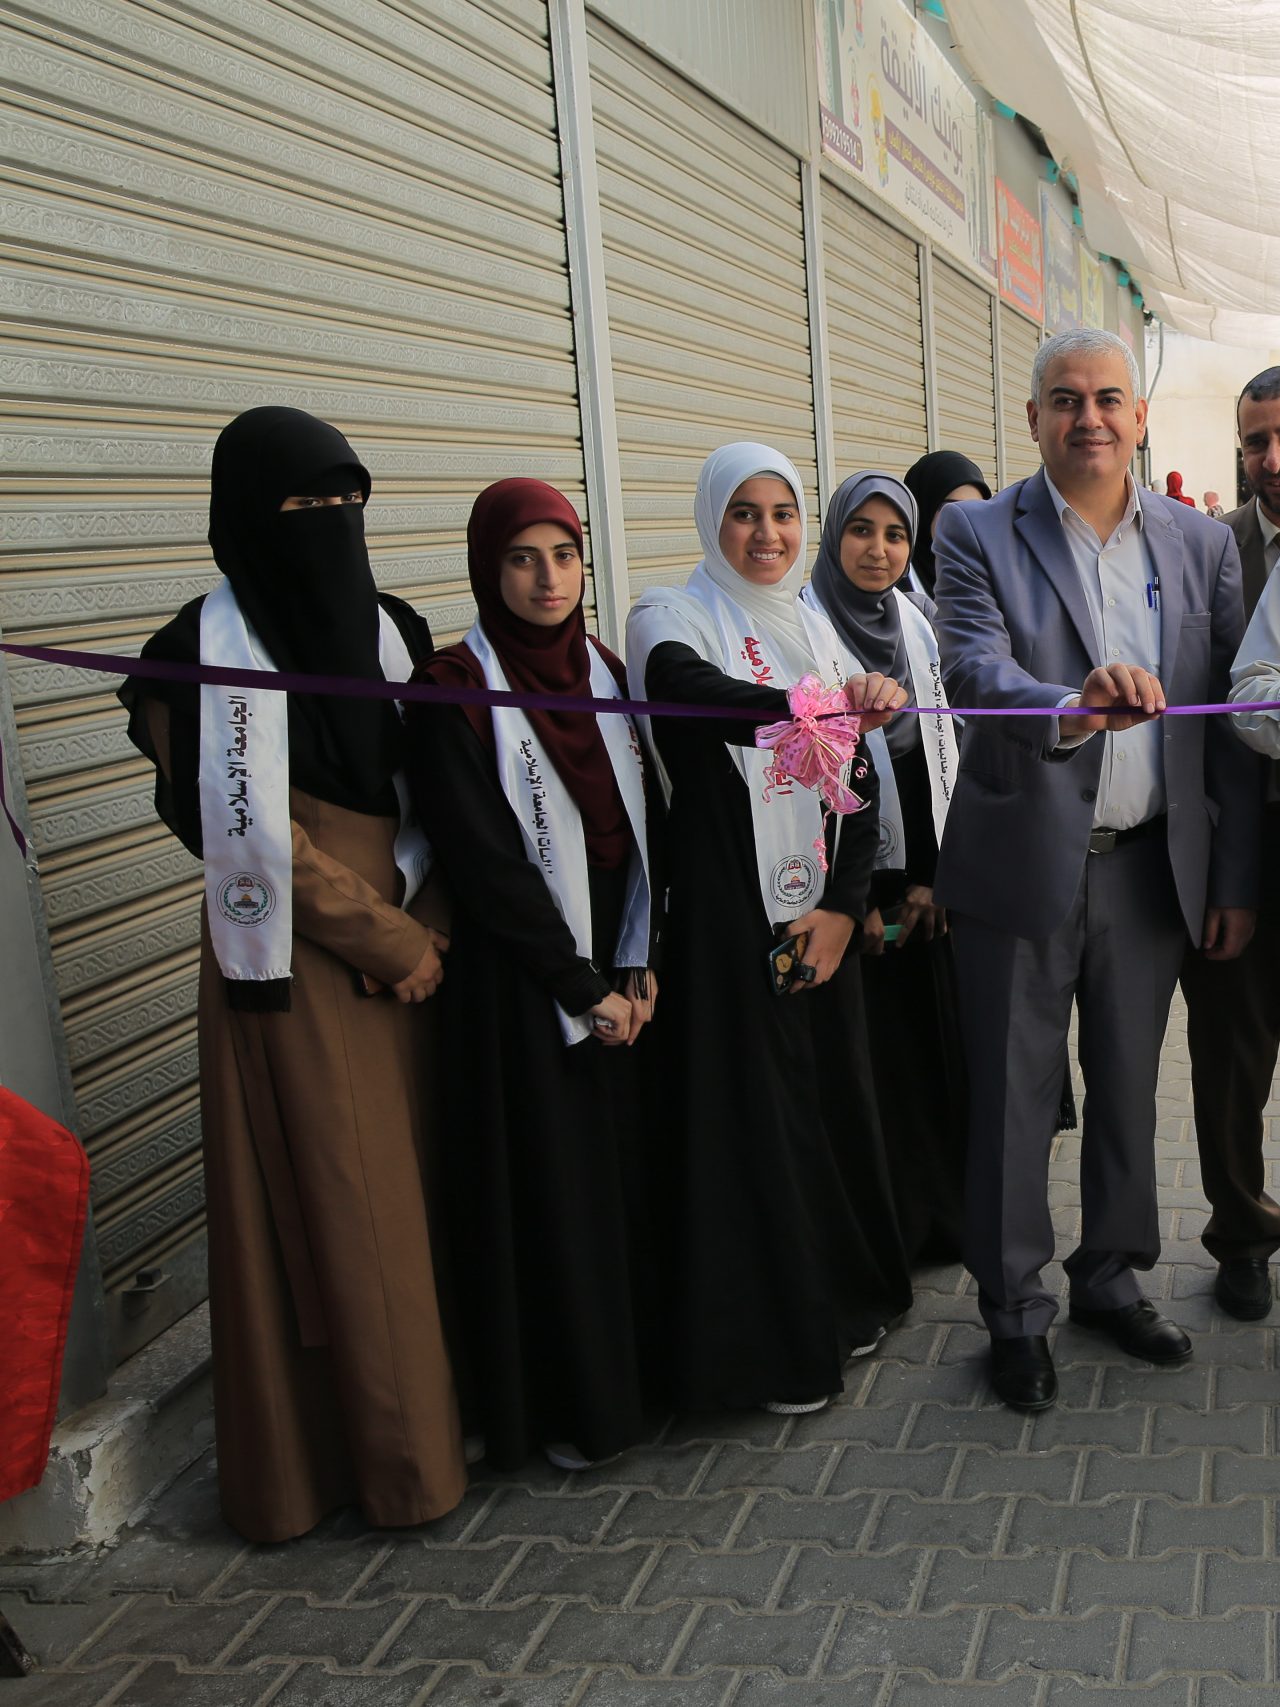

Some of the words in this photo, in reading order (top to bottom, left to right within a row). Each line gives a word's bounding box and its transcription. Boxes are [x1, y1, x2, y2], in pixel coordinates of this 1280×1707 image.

[880, 15, 927, 124] الأنيقة
[931, 85, 963, 177] بوتيك
[929, 661, 942, 702] الإسلامية
[226, 694, 253, 758] الجامعة
[935, 703, 945, 738] الجامة
[519, 738, 543, 790] الإسلامية
[938, 739, 949, 775] طالبات
[226, 761, 253, 838] الإسلامية
[531, 790, 547, 836] الجامعة
[940, 775, 951, 802] مجلس
